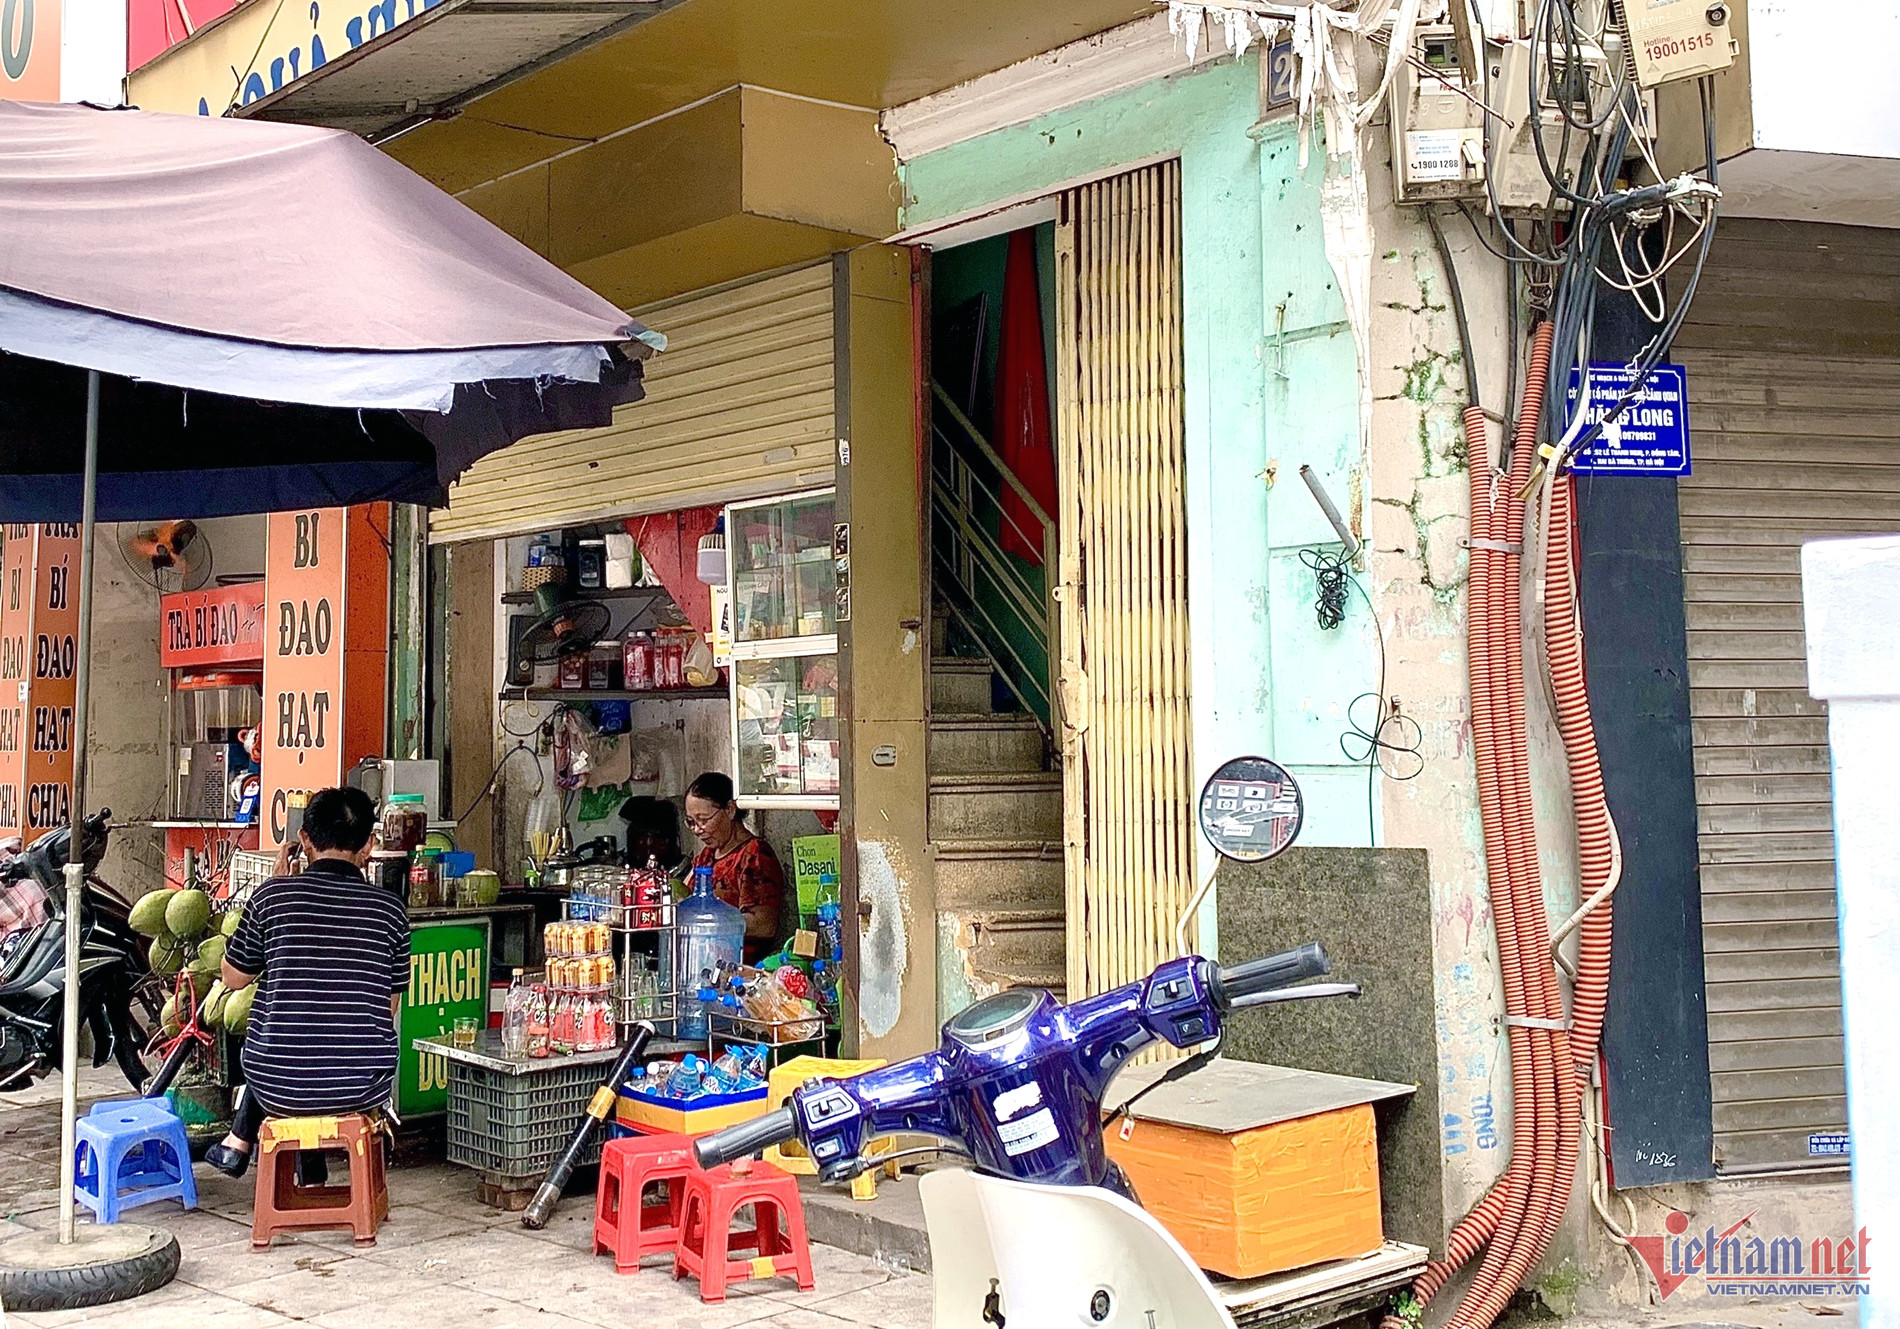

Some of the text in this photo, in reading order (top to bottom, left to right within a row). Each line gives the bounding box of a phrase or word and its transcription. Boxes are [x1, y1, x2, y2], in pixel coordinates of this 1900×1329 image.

[1643, 36, 1673, 48] Hotline:
[1645, 32, 1714, 61] 19001515
[1418, 159, 1459, 169] 1900 1288
[1632, 408, 1674, 427] LONG
[10, 555, 22, 610] BÍ
[49, 553, 68, 610] BÍ
[167, 596, 192, 651] TRÀ
[195, 594, 208, 648] BÍ
[210, 603, 238, 646] ĐAO
[279, 598, 332, 656] ĐAO
[2, 635, 24, 679] ĐAO
[36, 634, 75, 679] ĐAO
[33, 706, 72, 764] HẠT
[277, 691, 330, 765] HẠT
[0, 784, 18, 828] HIA
[28, 783, 70, 828] CHIA
[798, 857, 836, 876] Dasani
[408, 948, 481, 1016] THẠCH
[534, 1009, 548, 1024] C2
